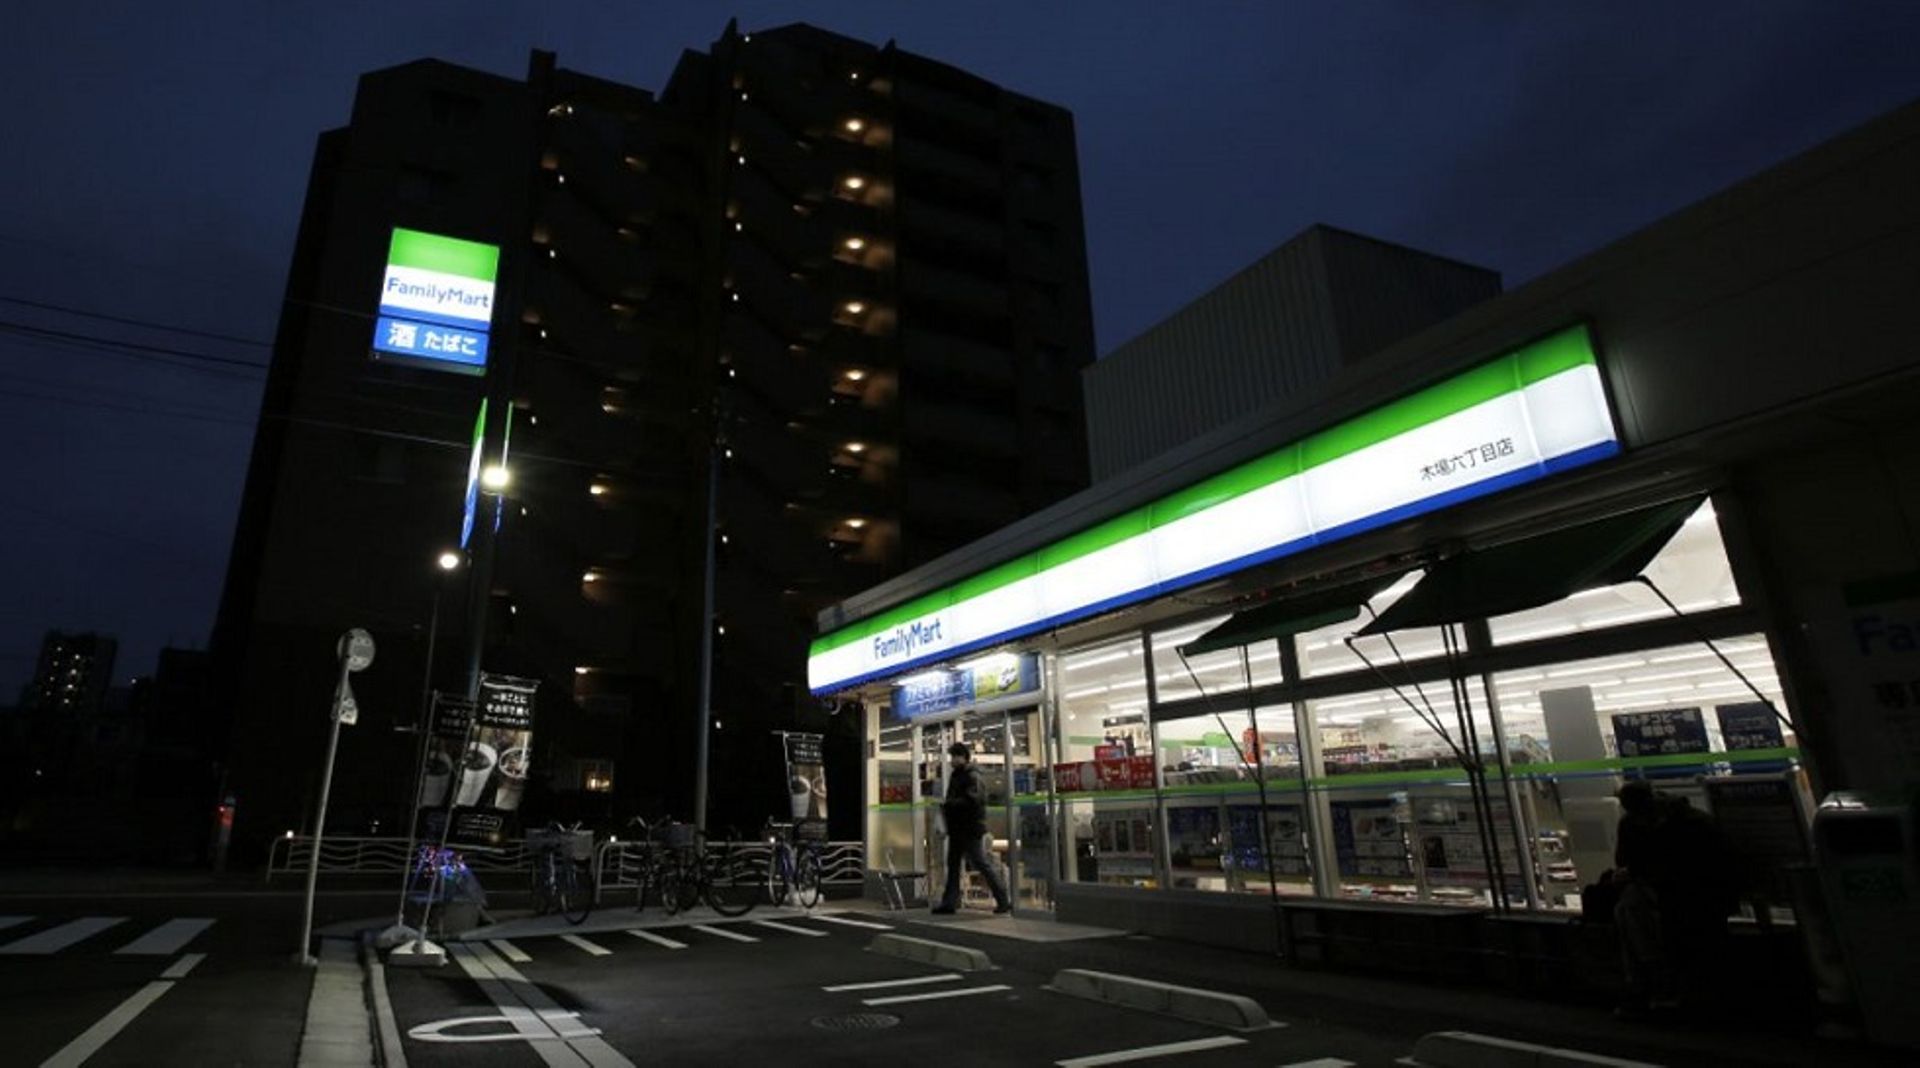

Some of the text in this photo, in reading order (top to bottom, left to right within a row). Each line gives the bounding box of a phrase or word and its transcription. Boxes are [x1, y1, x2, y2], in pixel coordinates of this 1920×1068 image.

[386, 277, 490, 308] FamilyMart
[388, 322, 478, 355] 酒 たばこ
[1420, 437, 1514, 481] 木場六丁目店
[873, 618, 943, 660] FamilyMart
[1853, 615, 1920, 656] Fa
